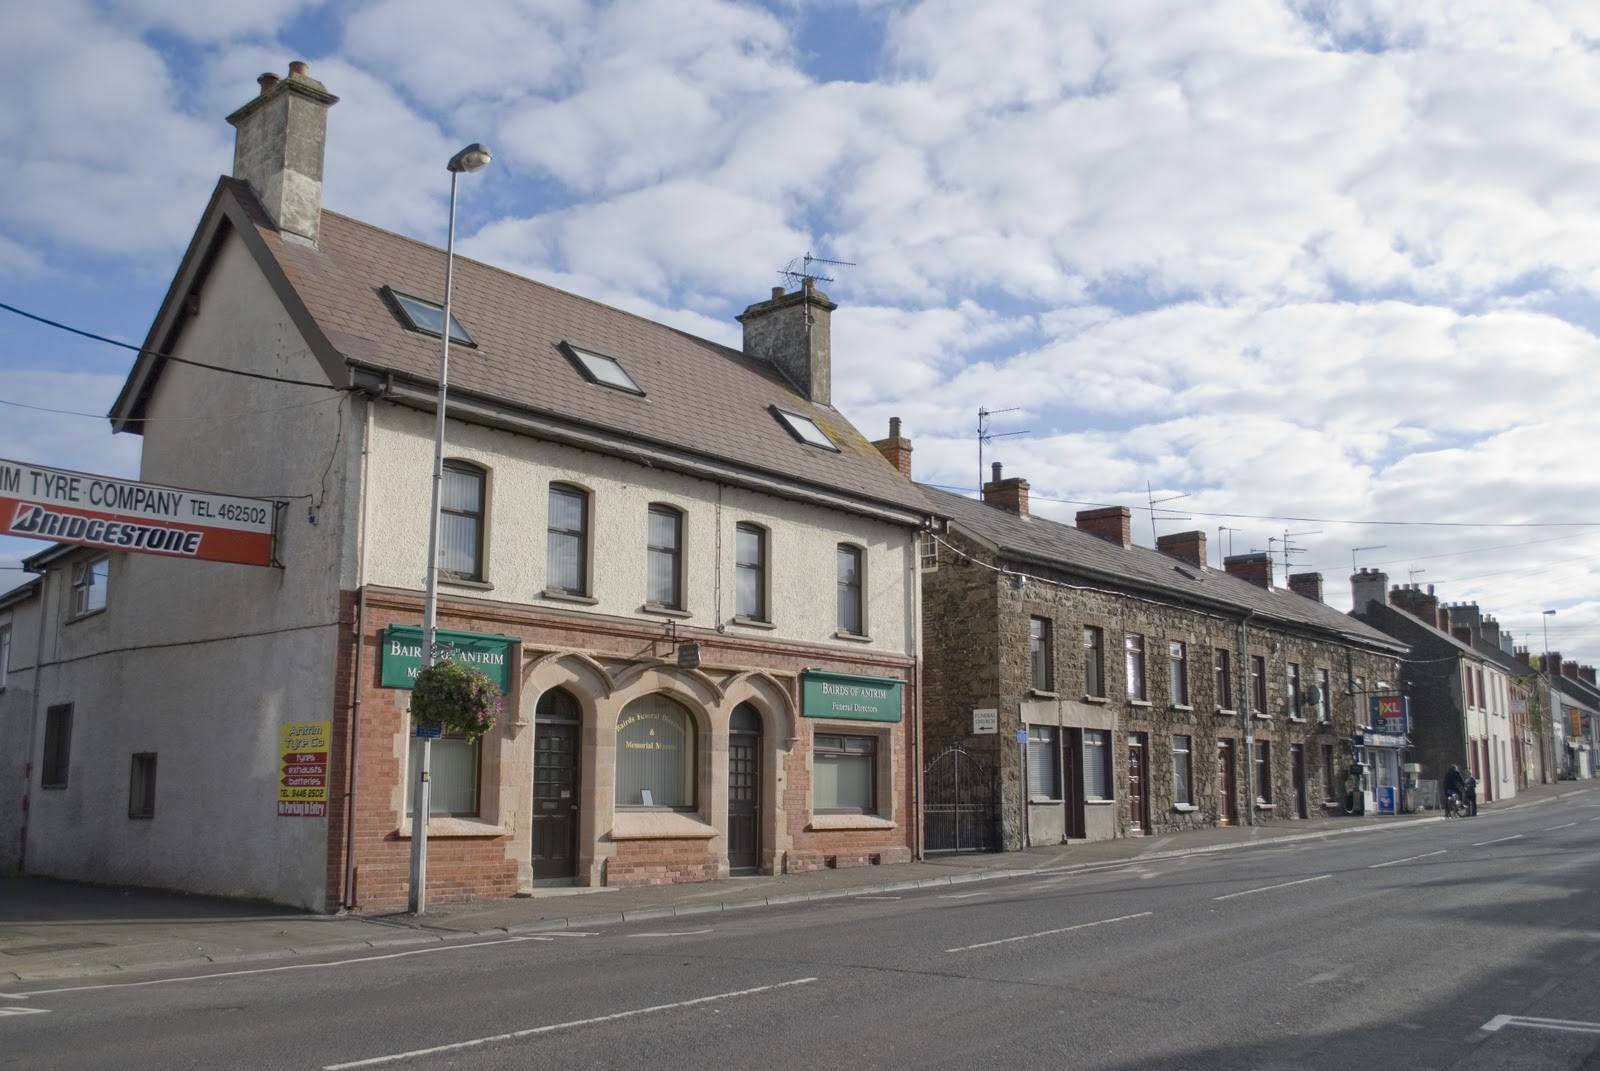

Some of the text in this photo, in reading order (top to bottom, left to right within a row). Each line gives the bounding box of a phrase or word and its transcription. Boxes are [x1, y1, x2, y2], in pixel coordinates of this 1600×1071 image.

[30, 470, 82, 502] TYRE
[89, 480, 183, 517] COMPANY
[190, 499, 216, 518] TEL.
[218, 503, 266, 525] 462502
[11, 505, 202, 554] BRIDGESTONE
[459, 651, 504, 665] ANTRIM
[822, 682, 887, 699] BAIRDS OF ANTRIM
[832, 702, 878, 713] Funeral Directors
[1384, 702, 1400, 713] XL
[289, 726, 322, 736] Antrim
[649, 728, 655, 736] &
[285, 737, 324, 750] Tyre Co
[625, 740, 654, 750] Memorial
[296, 754, 315, 763] tyres
[288, 766, 322, 774] exhausts
[288, 778, 321, 786] batteries
[292, 789, 307, 798] 9446
[307, 789, 324, 798] 2502
[285, 802, 304, 816] Parking
[310, 802, 324, 816] Entry
